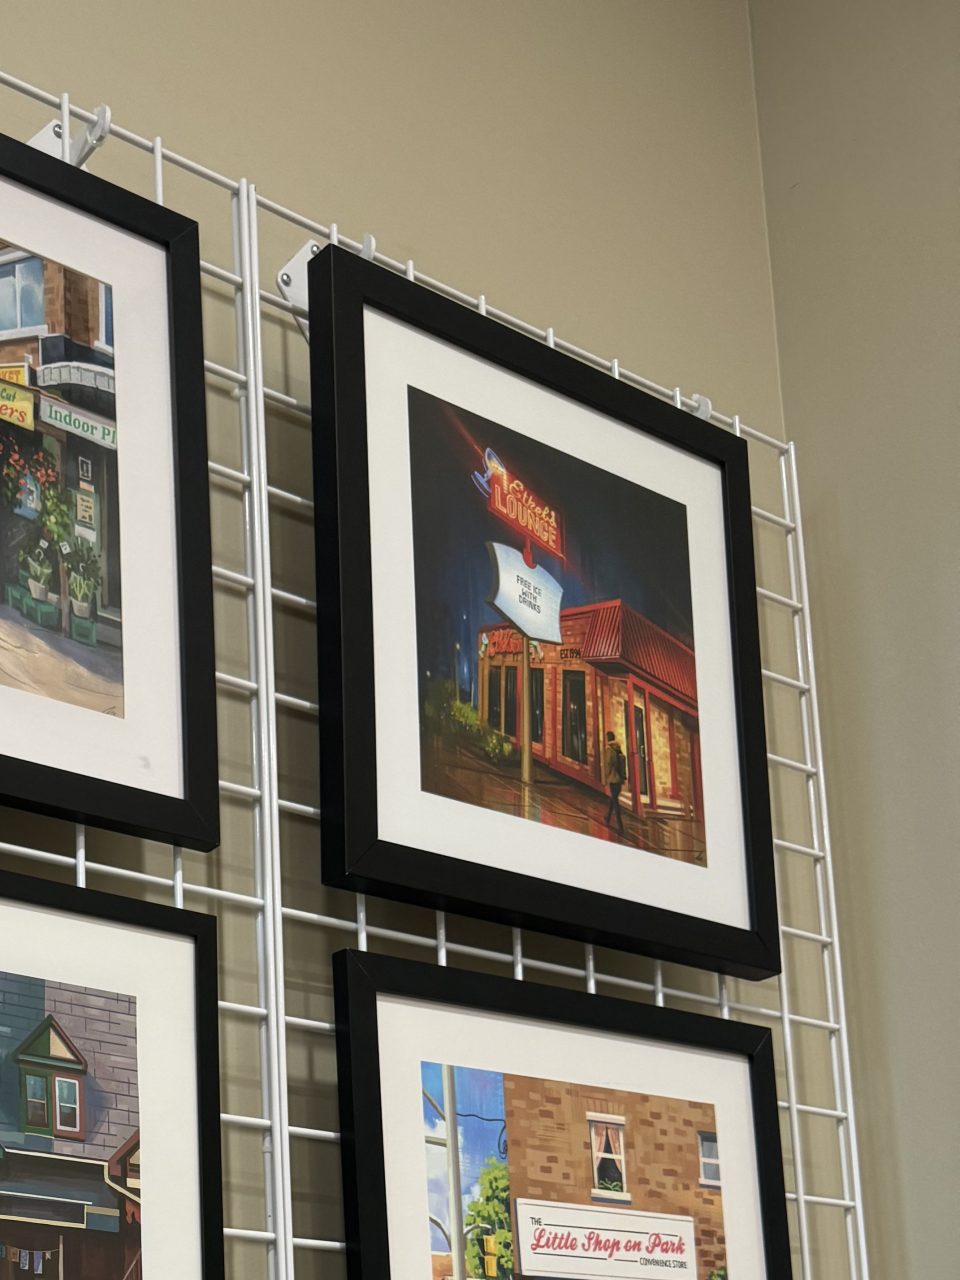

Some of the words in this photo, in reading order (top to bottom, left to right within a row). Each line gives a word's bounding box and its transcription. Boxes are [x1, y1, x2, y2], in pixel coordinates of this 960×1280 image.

[0, 387, 17, 402] Cut
[47, 405, 98, 437] Indoor
[494, 484, 557, 548] LOUNGE
[516, 574, 531, 591] FREE
[533, 585, 541, 597] ICE
[521, 588, 537, 603] WITH
[519, 594, 541, 614] DRINKS
[530, 1216, 542, 1226] THE
[530, 1227, 578, 1252] Little
[581, 1231, 620, 1258] Shop
[623, 1239, 641, 1253] on
[645, 1233, 686, 1255] Park
[639, 1257, 671, 1268] CONVENIENCE
[672, 1259, 688, 1269] STORE
